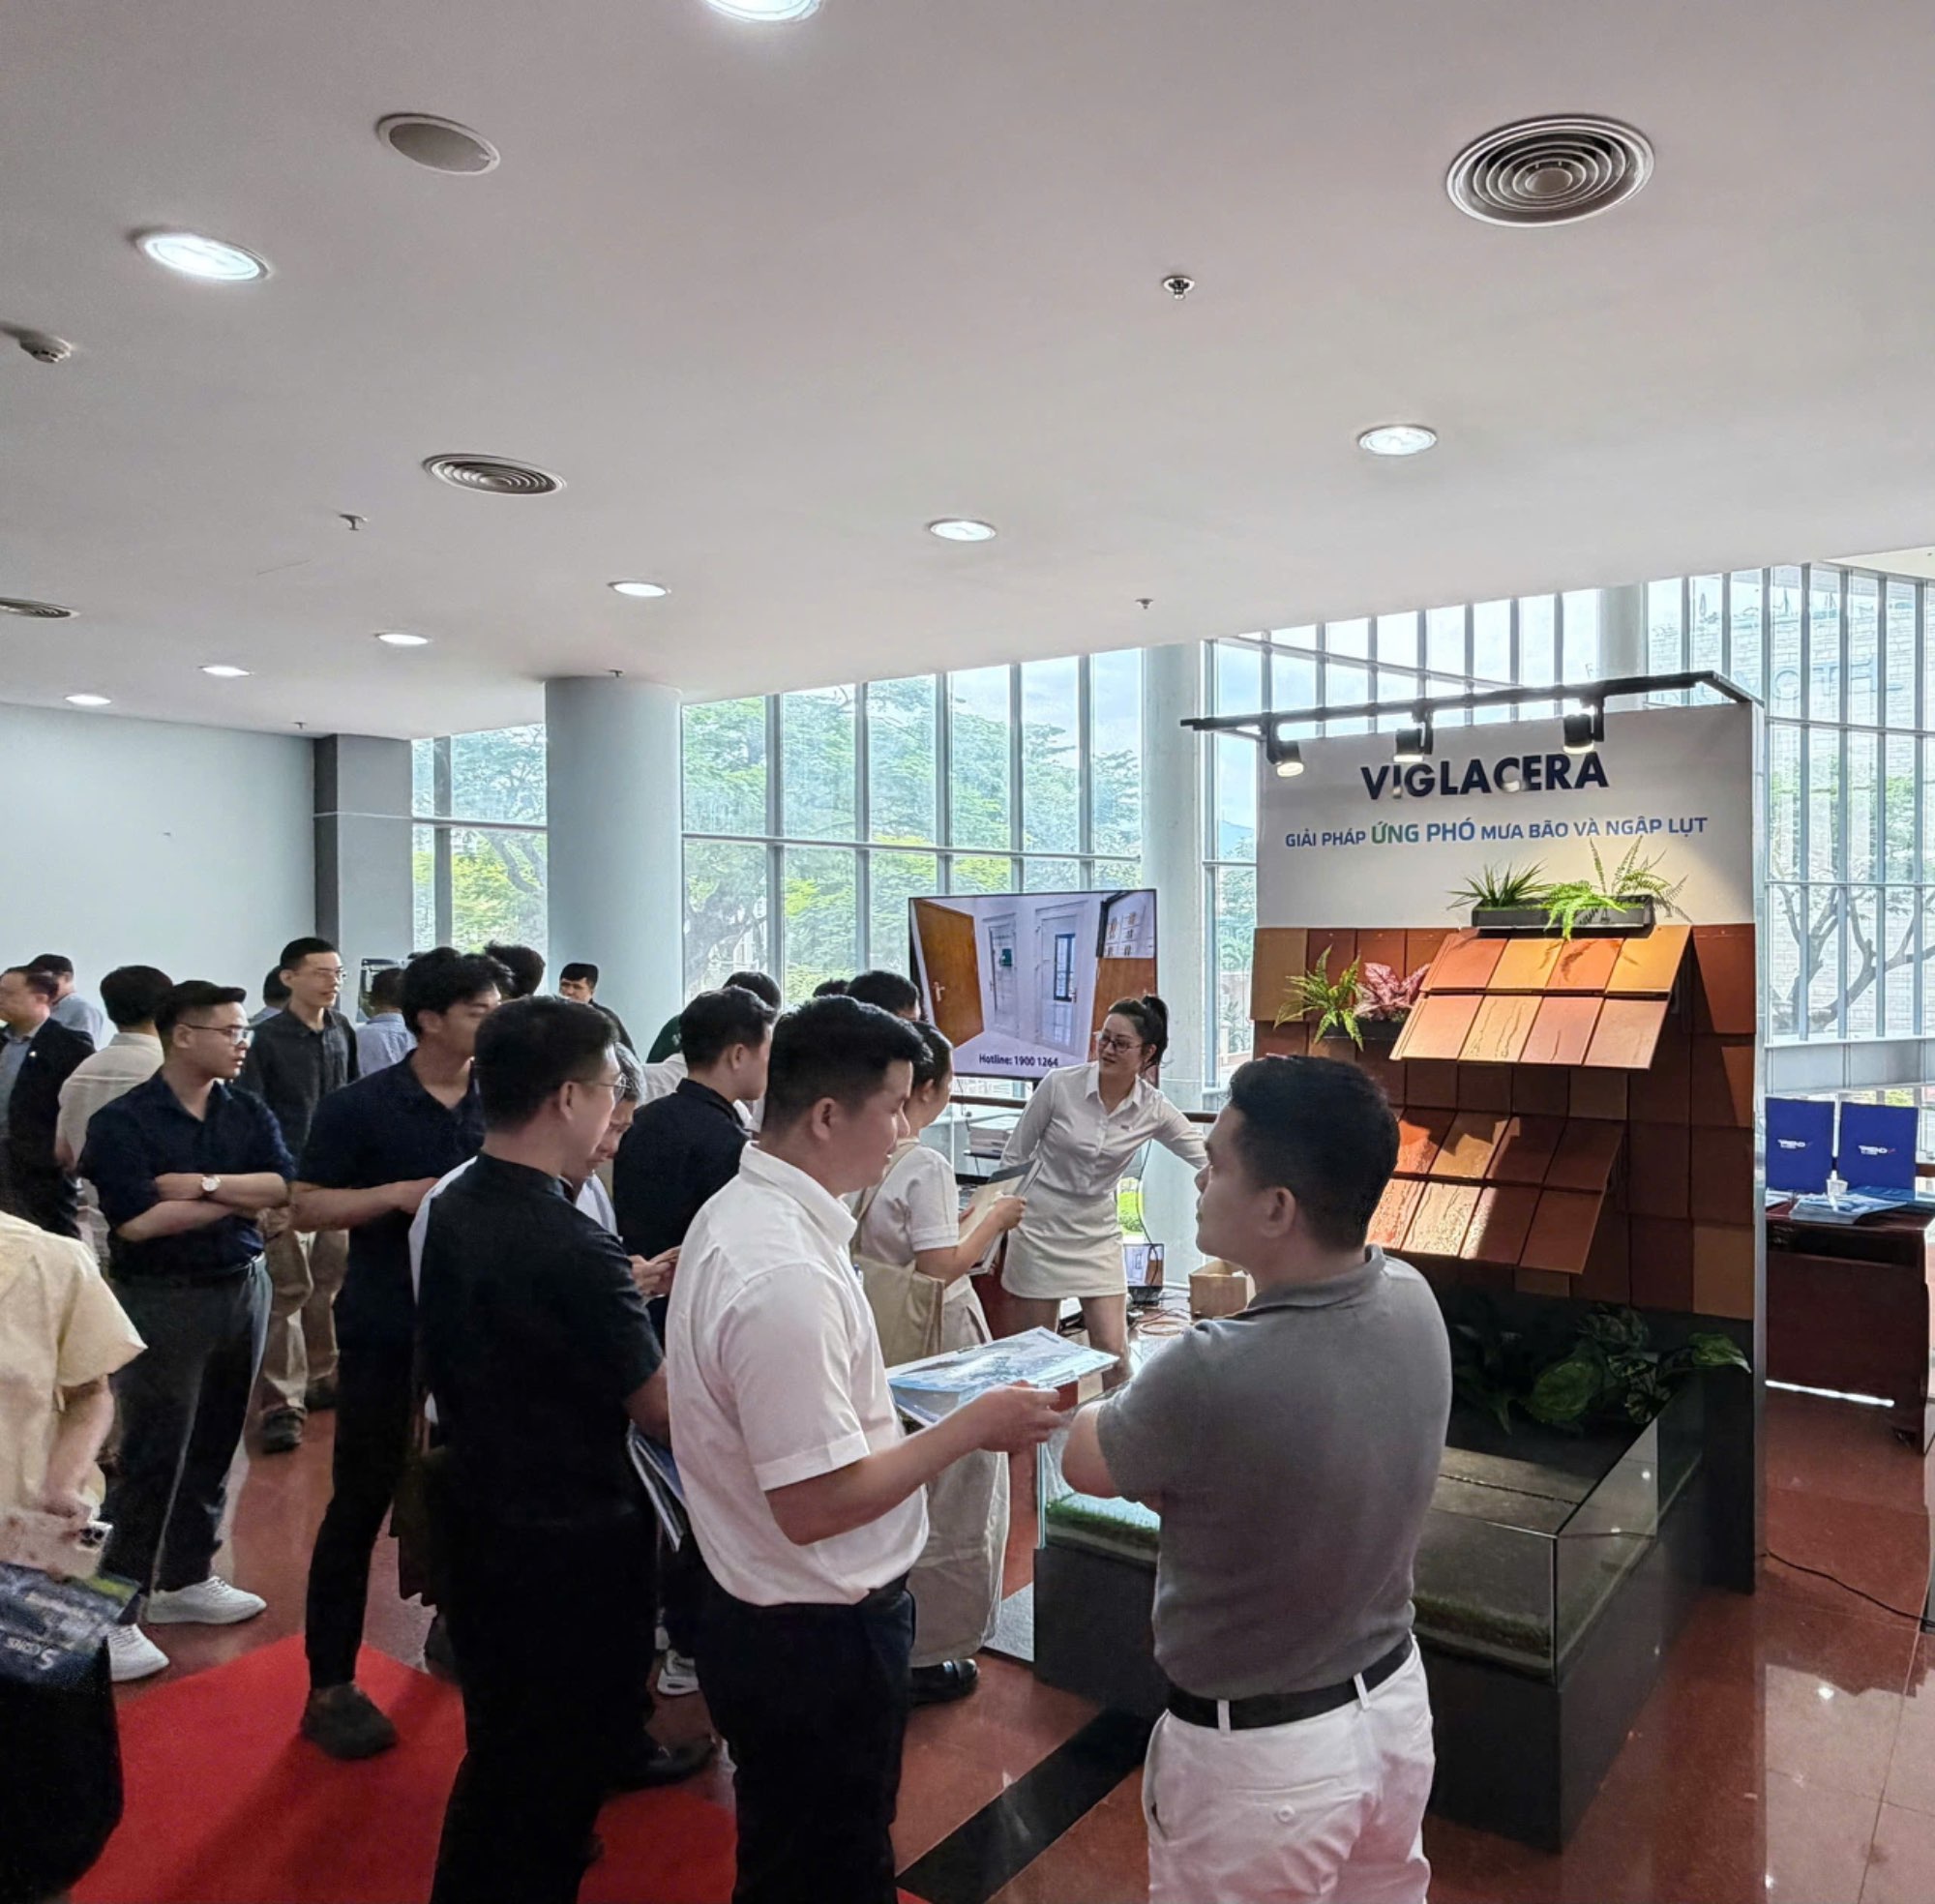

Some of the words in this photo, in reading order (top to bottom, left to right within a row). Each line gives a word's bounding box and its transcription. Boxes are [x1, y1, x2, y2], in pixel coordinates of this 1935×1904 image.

[1360, 752, 1609, 800] VIGLACERA
[1286, 828, 1317, 848] GIẢI
[1322, 827, 1366, 847] PHÁP
[1371, 820, 1419, 845] ỨNG
[1427, 818, 1475, 843] PHÓ
[1481, 822, 1524, 841] MƯA
[1529, 820, 1568, 839] BÃO
[1574, 817, 1600, 837] VÀ
[1669, 817, 1708, 838] LỤT
[979, 1054, 1012, 1065] Hotline:
[1014, 1056, 1035, 1066] 1900
[1037, 1056, 1058, 1067] 1264
